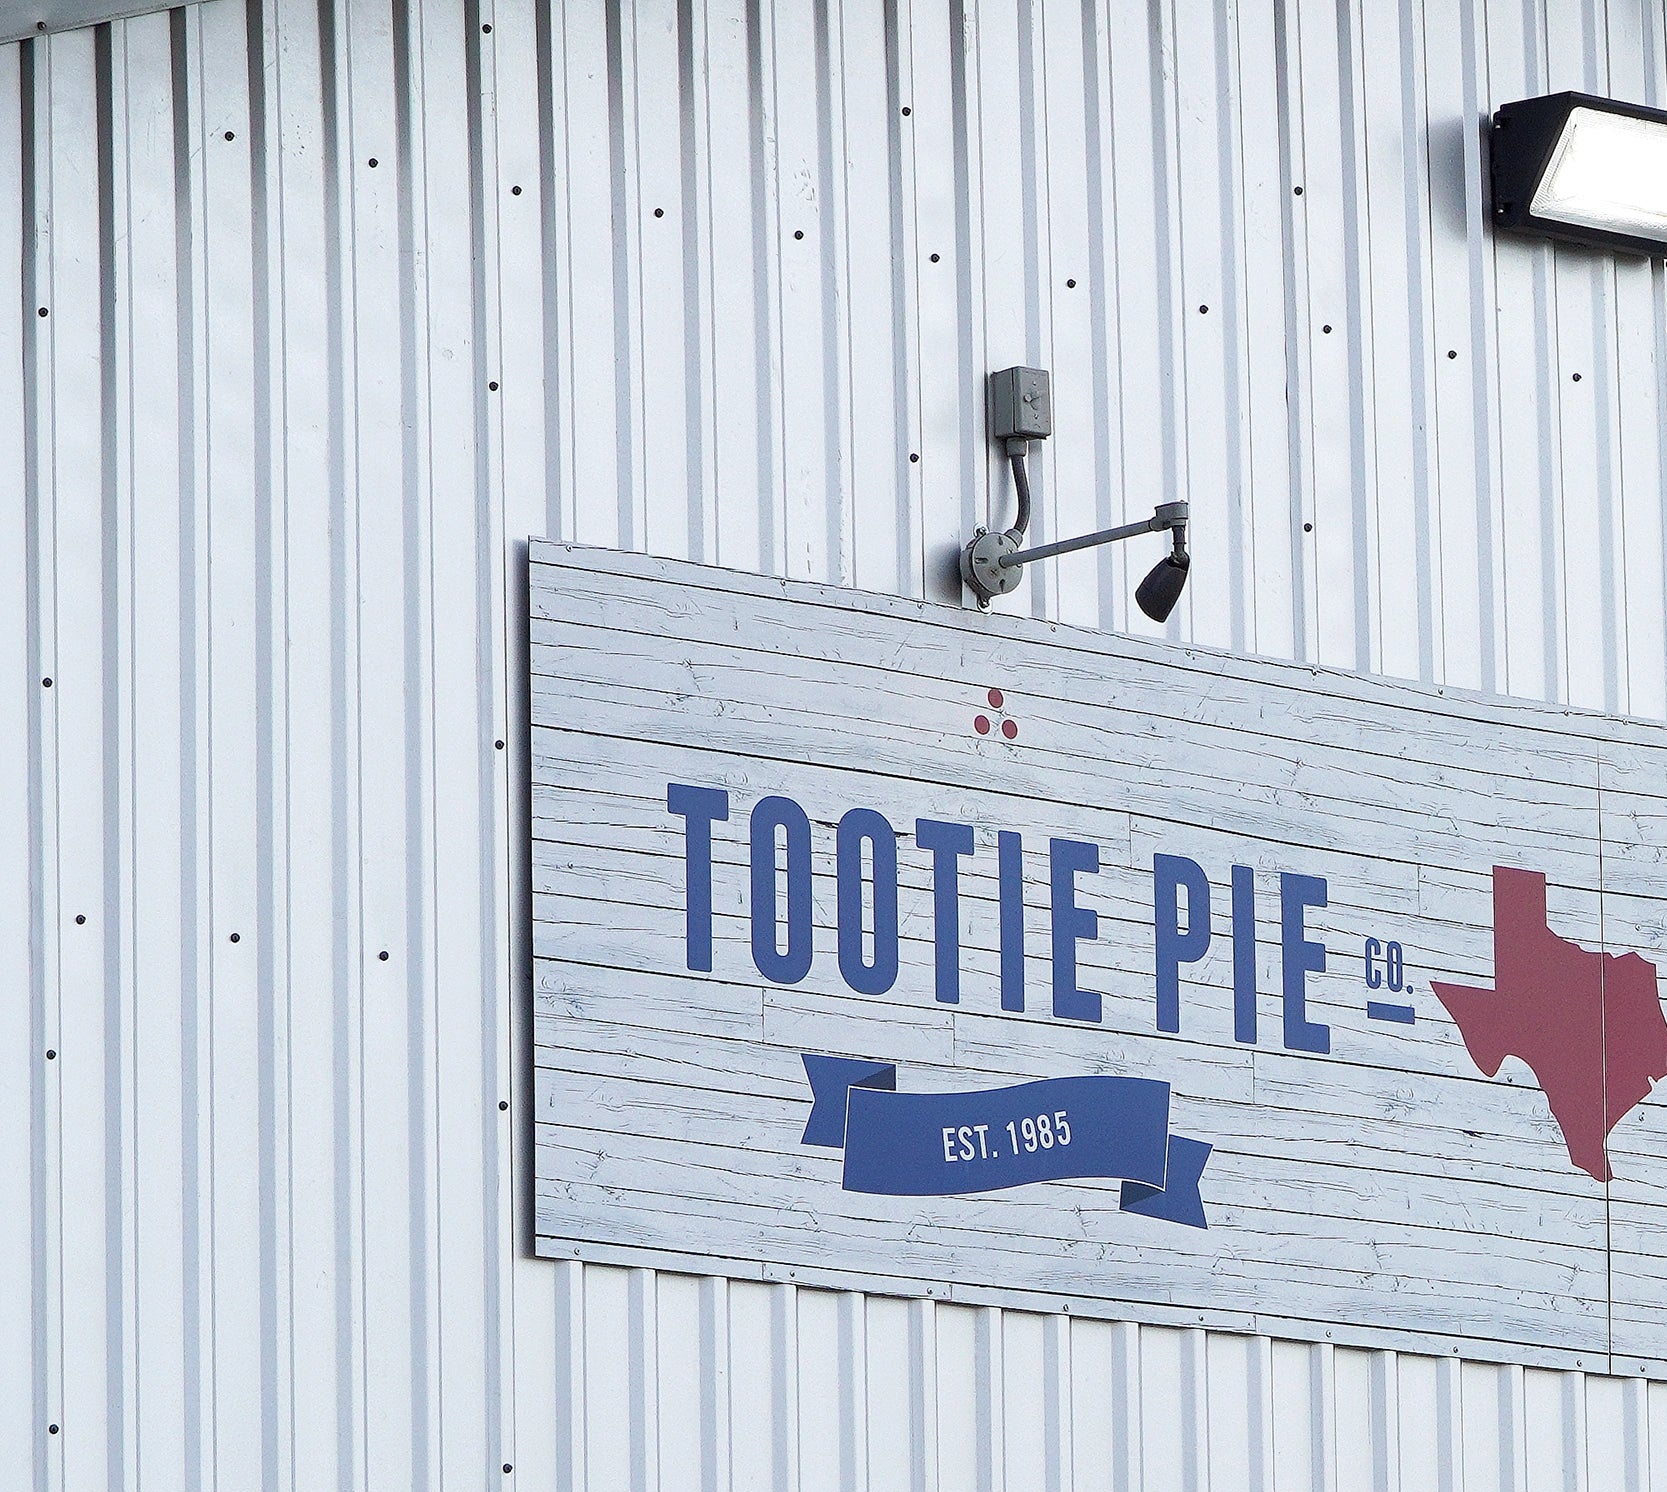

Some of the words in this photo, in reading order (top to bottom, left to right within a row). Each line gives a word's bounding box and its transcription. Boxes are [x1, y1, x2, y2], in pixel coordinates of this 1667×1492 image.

[667, 782, 1102, 1023] TOOTIE
[1154, 853, 1331, 1054] PIE
[1365, 937, 1414, 994] CO.
[942, 1124, 998, 1162] EST.
[1006, 1110, 1072, 1155] 1985
